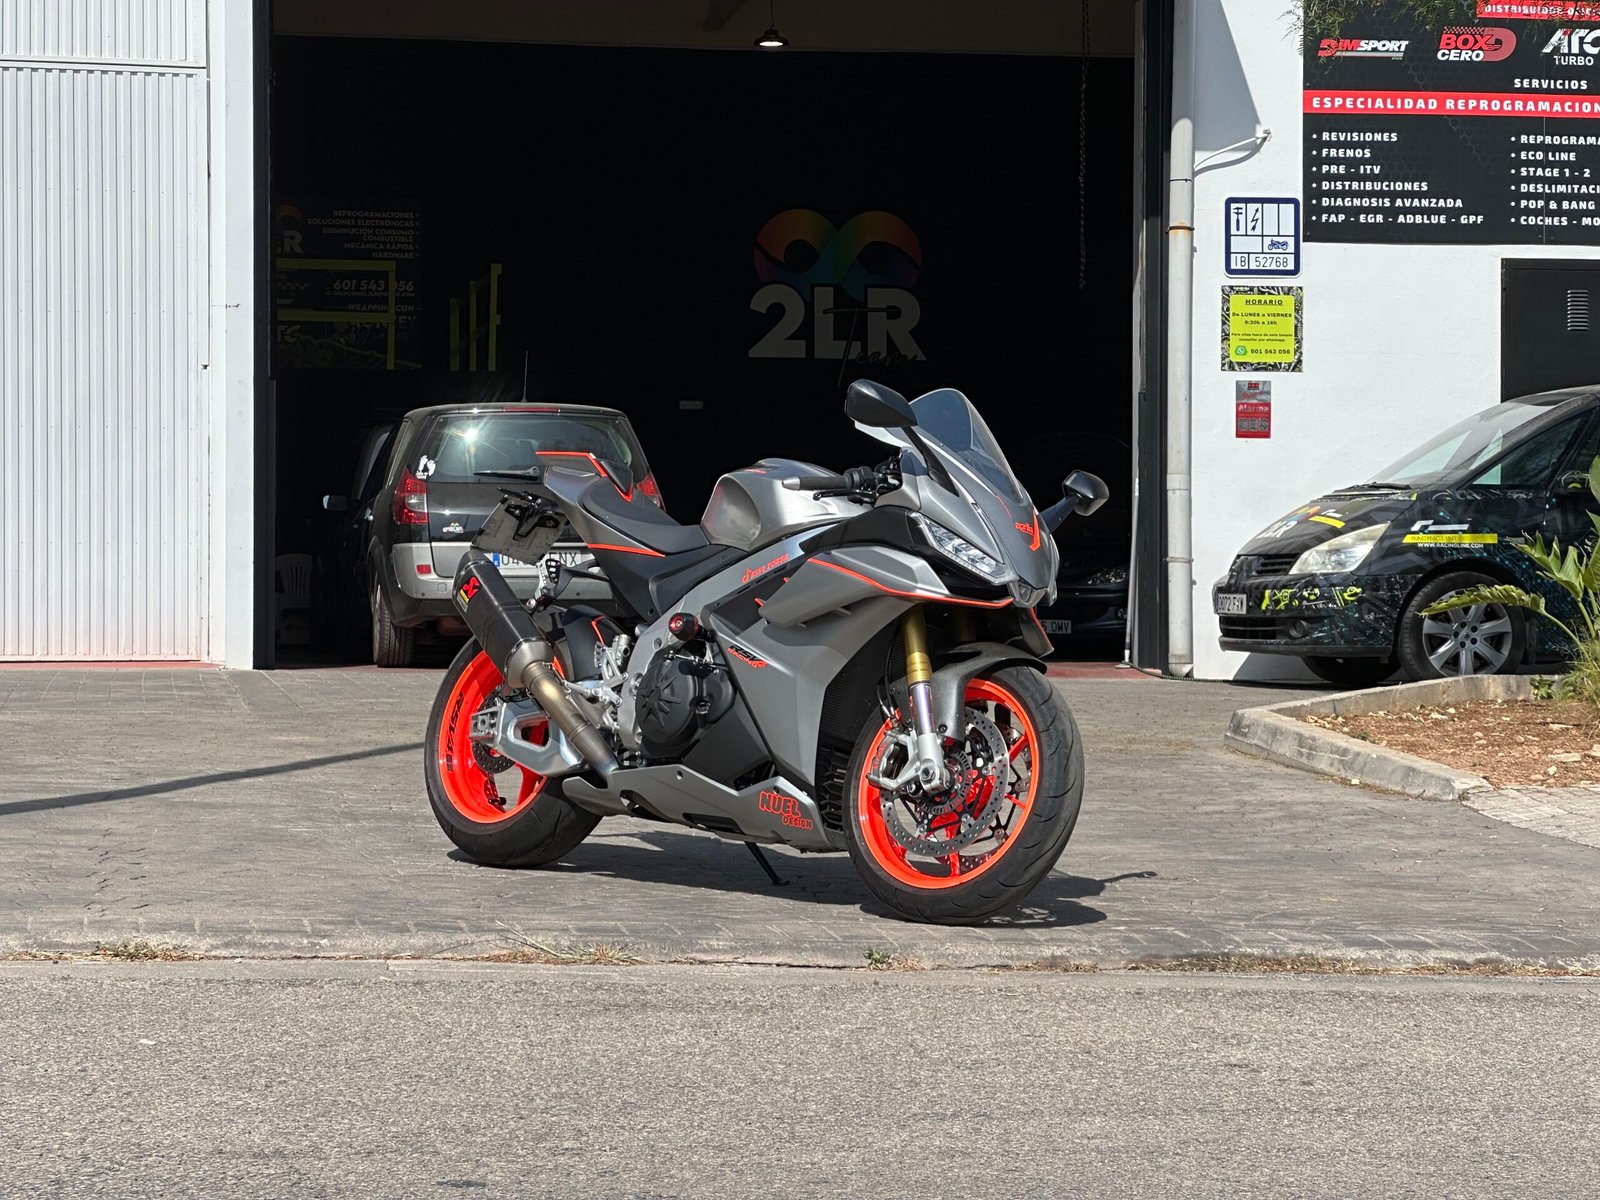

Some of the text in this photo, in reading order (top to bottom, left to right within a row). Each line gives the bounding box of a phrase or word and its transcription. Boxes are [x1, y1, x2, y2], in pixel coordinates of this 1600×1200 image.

[1440, 33, 1492, 51] BOX
[1437, 49, 1485, 61] CERO
[1553, 55, 1594, 66] TURBO
[1513, 78, 1588, 90] SERVICIOS
[1312, 97, 1438, 109] ESPECIALIDAD
[1322, 131, 1398, 142] REVISIONES
[1322, 148, 1371, 158] FRENOS
[1520, 151, 1577, 161] ECO LINE
[1322, 165, 1346, 174] PRE
[1360, 165, 1381, 174] ITV
[1520, 167, 1560, 177] STAGE
[1563, 168, 1570, 177] 1
[1583, 168, 1591, 178] 2
[1322, 181, 1429, 191] DISTRIBUCIONES
[1322, 198, 1464, 208] DIAGNOSIS AVANZADA
[1520, 200, 1596, 210] POP & BANG
[1322, 213, 1346, 223] FAP
[1360, 214, 1384, 223] EGR
[1397, 215, 1447, 224] ADBLUE
[1460, 215, 1484, 224] GPF
[1520, 216, 1568, 226] COCHES
[1254, 256, 1289, 268] 52768
[333, 279, 357, 291] 601
[359, 280, 386, 291] 543
[1245, 298, 1284, 306] HORARIO
[748, 283, 928, 361] 2LR
[759, 790, 801, 818] NUEL
